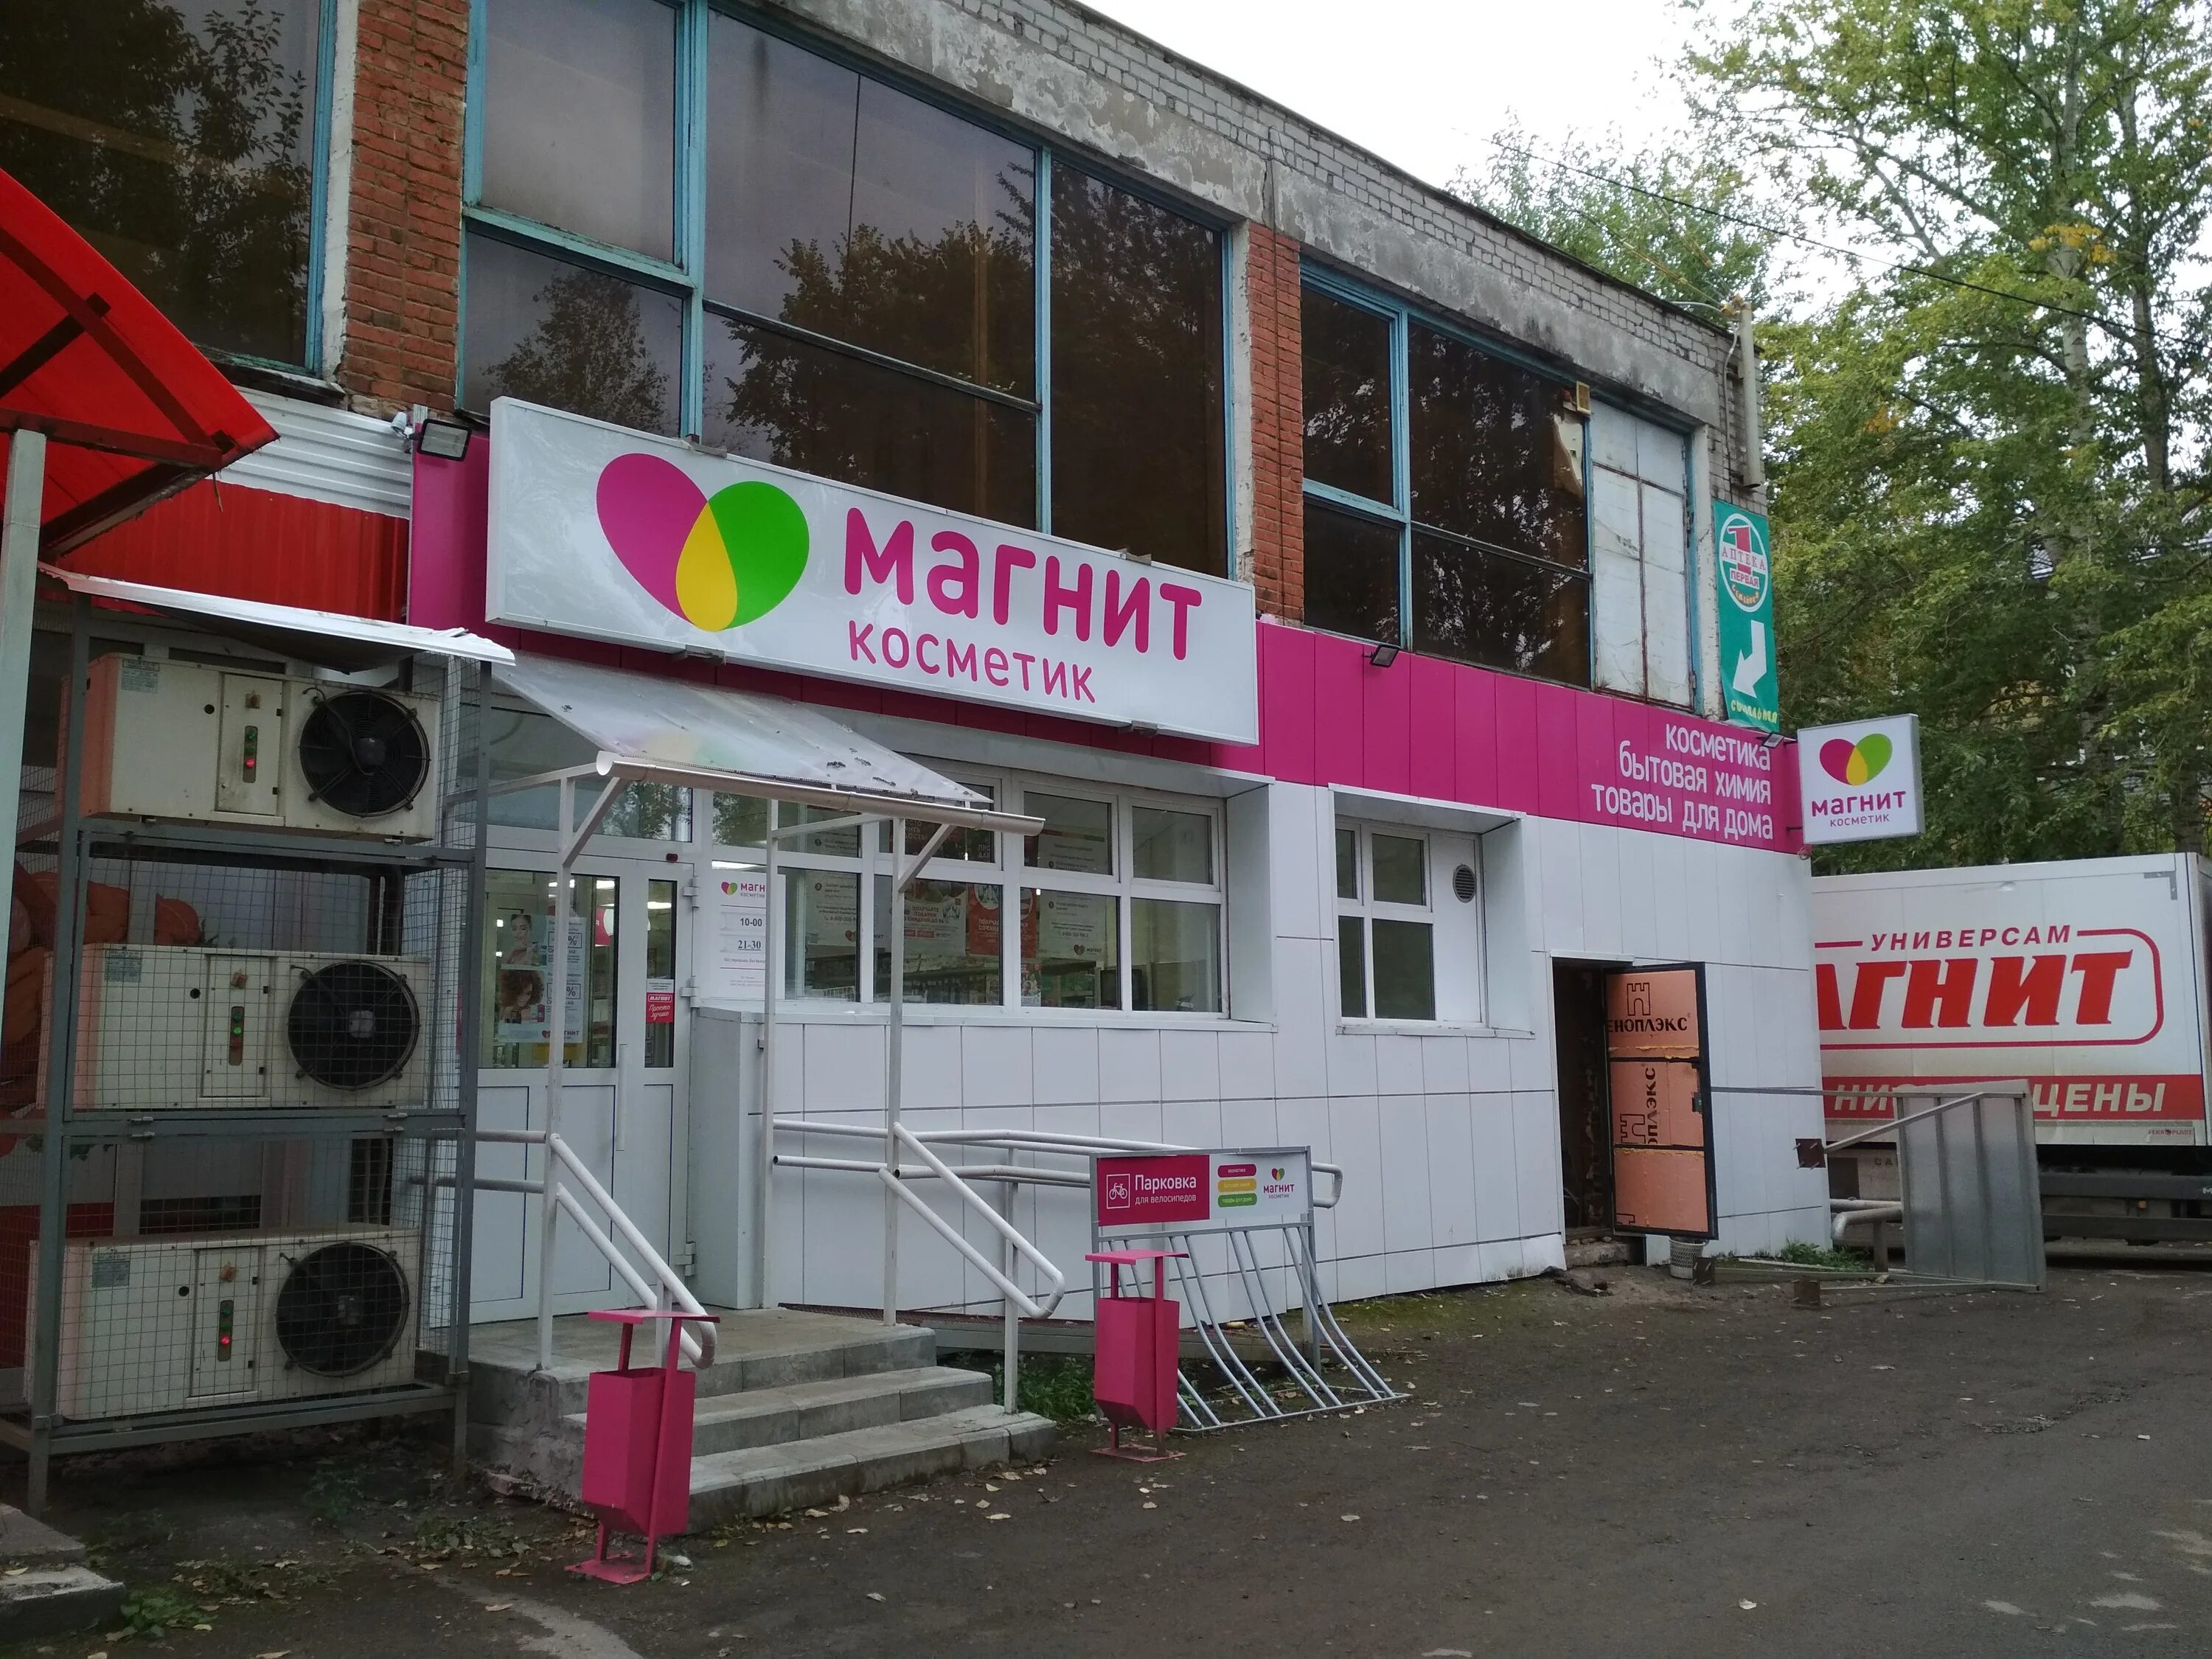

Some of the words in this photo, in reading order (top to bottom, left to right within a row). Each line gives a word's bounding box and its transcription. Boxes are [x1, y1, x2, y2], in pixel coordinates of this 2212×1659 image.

[1722, 547, 1766, 571] АПТЕКА
[844, 507, 1202, 660] магнит
[1731, 571, 1759, 588] ПЕРВАЯ
[849, 620, 1096, 703] косметик
[1666, 724, 1771, 771] косметика
[1619, 740, 1707, 793] бытовая
[1716, 769, 1771, 805] химия
[1591, 784, 1672, 824] товары
[1682, 801, 1720, 834] для
[1724, 809, 1773, 841] дома
[1811, 790, 1907, 817] магнит
[1829, 814, 1890, 827] косметик
[740, 883, 765, 892] магн
[740, 917, 762, 927] 10-00
[738, 939, 761, 950] 21-30
[1871, 925, 2071, 951] УНИВЕРСАМ
[1815, 950, 2134, 1031] ГНИТ
[1607, 1018, 1688, 1033] ЕНОПЛЭКС
[2032, 1083, 2166, 1117] ЦЕНЫ
[1135, 1175, 1197, 1194] Парковка
[1263, 1184, 1295, 1193] магнит
[1135, 1196, 1149, 1205] для
[1150, 1194, 1197, 1204] велосипедов
